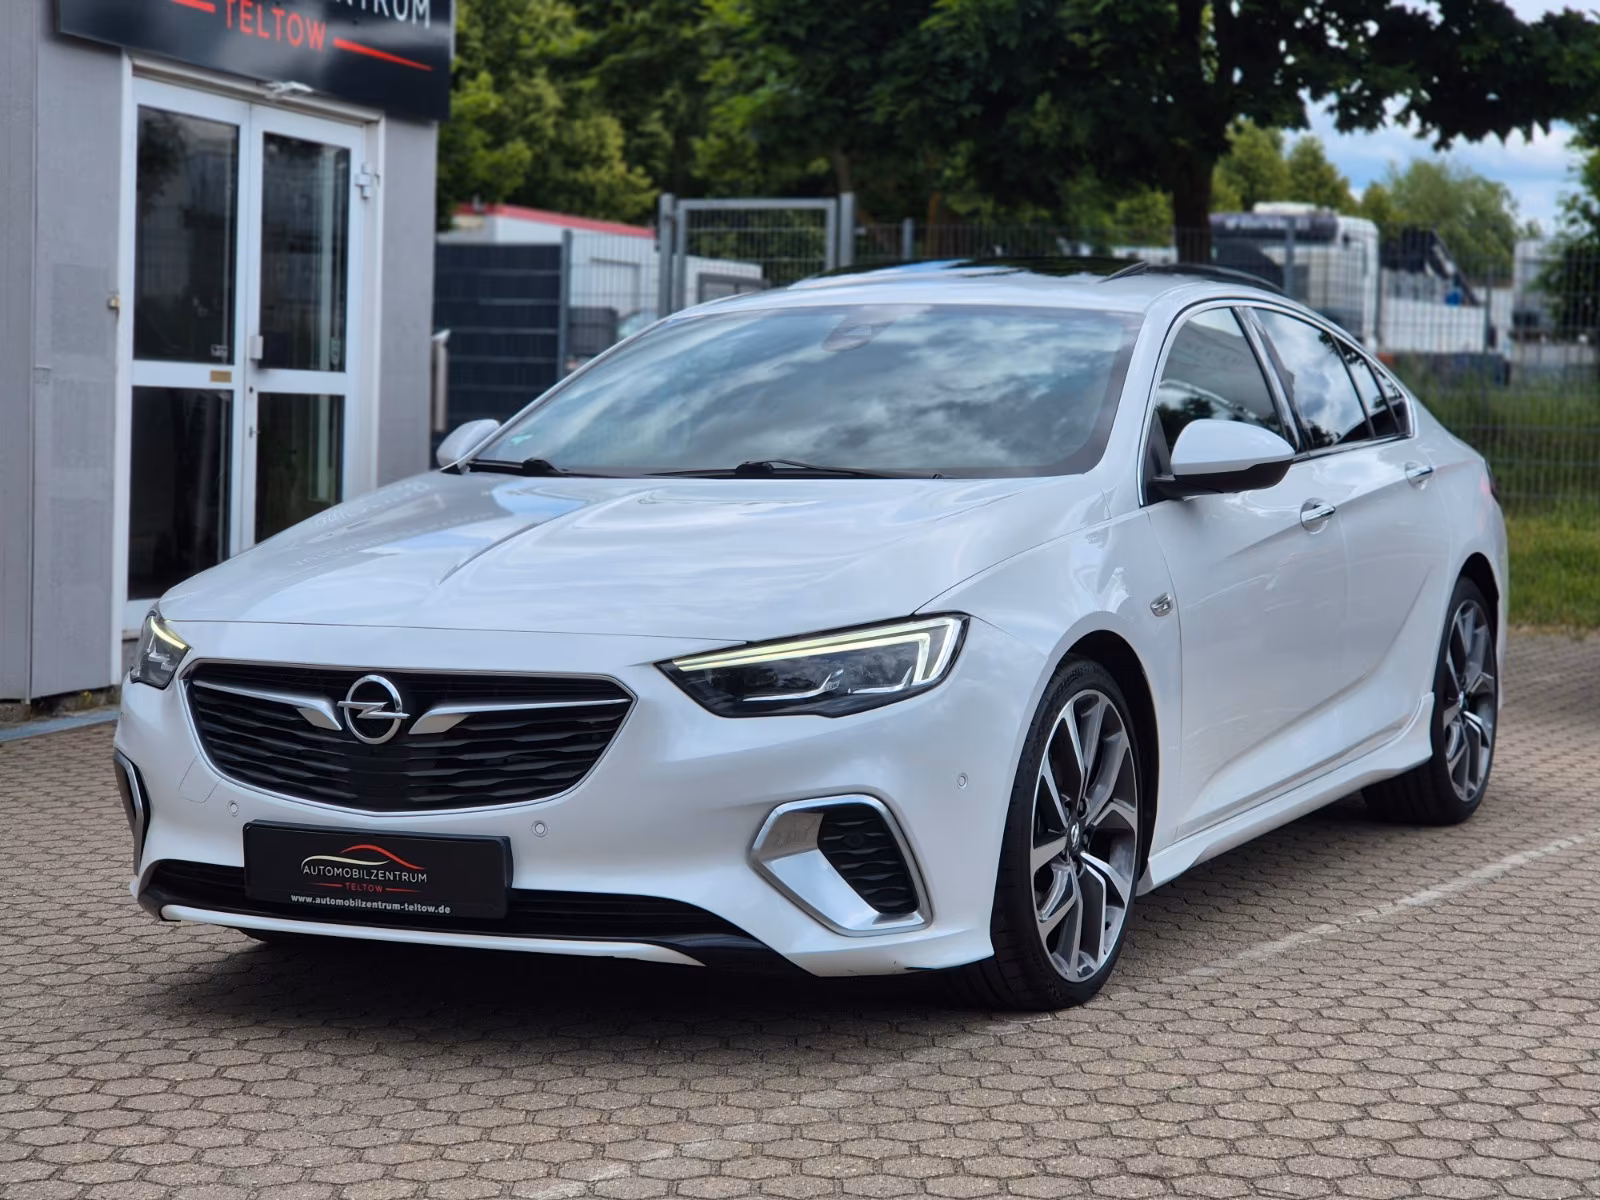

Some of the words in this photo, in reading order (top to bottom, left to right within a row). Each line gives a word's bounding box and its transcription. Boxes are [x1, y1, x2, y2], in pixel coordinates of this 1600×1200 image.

[225, 0, 327, 51] TELTOW
[303, 865, 427, 883] AUTOMOBILZENTRUM
[345, 882, 383, 893] TELTOW
[290, 894, 451, 914] www.automobilzentrum-teltow.de
